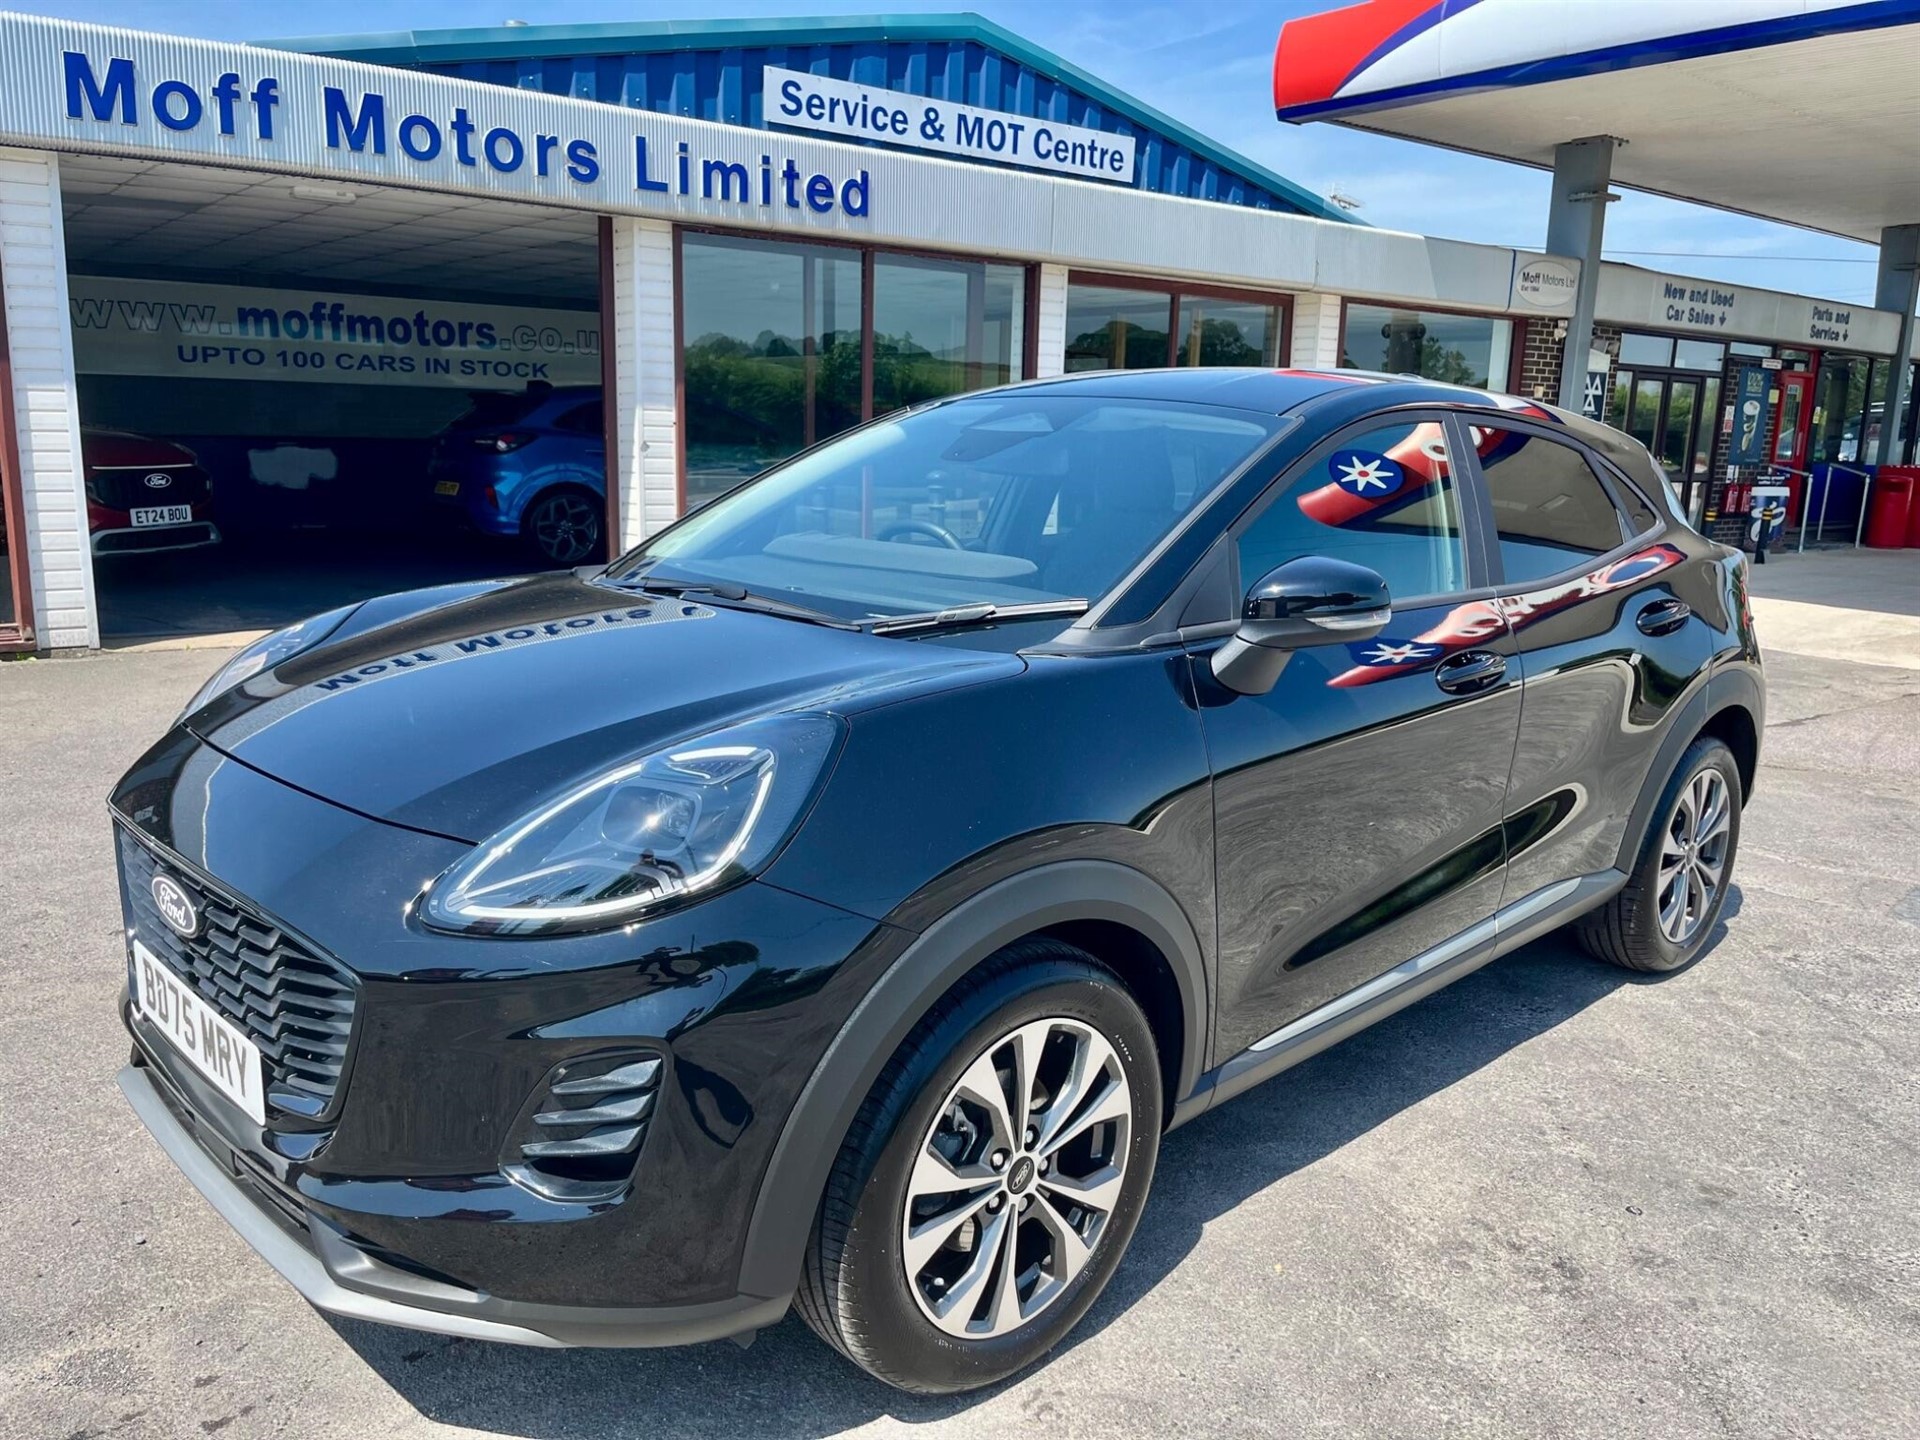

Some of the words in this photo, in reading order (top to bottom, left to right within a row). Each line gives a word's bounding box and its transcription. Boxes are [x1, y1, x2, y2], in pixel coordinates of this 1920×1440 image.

[62, 51, 279, 140] Moff
[324, 86, 600, 184] Motors
[634, 136, 869, 218] Limited
[780, 80, 908, 136] Service
[920, 107, 945, 143] &
[957, 115, 1025, 155] MOT
[1033, 127, 1124, 173] Centre
[1522, 271, 1541, 284] Moff
[1541, 273, 1565, 287] Motors
[1664, 282, 1685, 301] New
[1689, 287, 1707, 304] and
[1711, 289, 1734, 308] Used
[1666, 304, 1685, 321] Car
[1688, 307, 1715, 326] Sales
[1812, 306, 1833, 324] Parts
[1835, 310, 1850, 325] and
[1810, 325, 1840, 342] Service
[177, 345, 266, 366] UPTO
[276, 351, 326, 369] 100
[335, 353, 416, 372] CARS
[425, 358, 450, 374] IN
[460, 360, 549, 378] STOCK
[135, 509, 166, 524] ET24
[167, 507, 188, 521] BOU
[158, 882, 188, 928] Ford
[143, 956, 196, 1050] BD75
[199, 1009, 247, 1097] MRY
